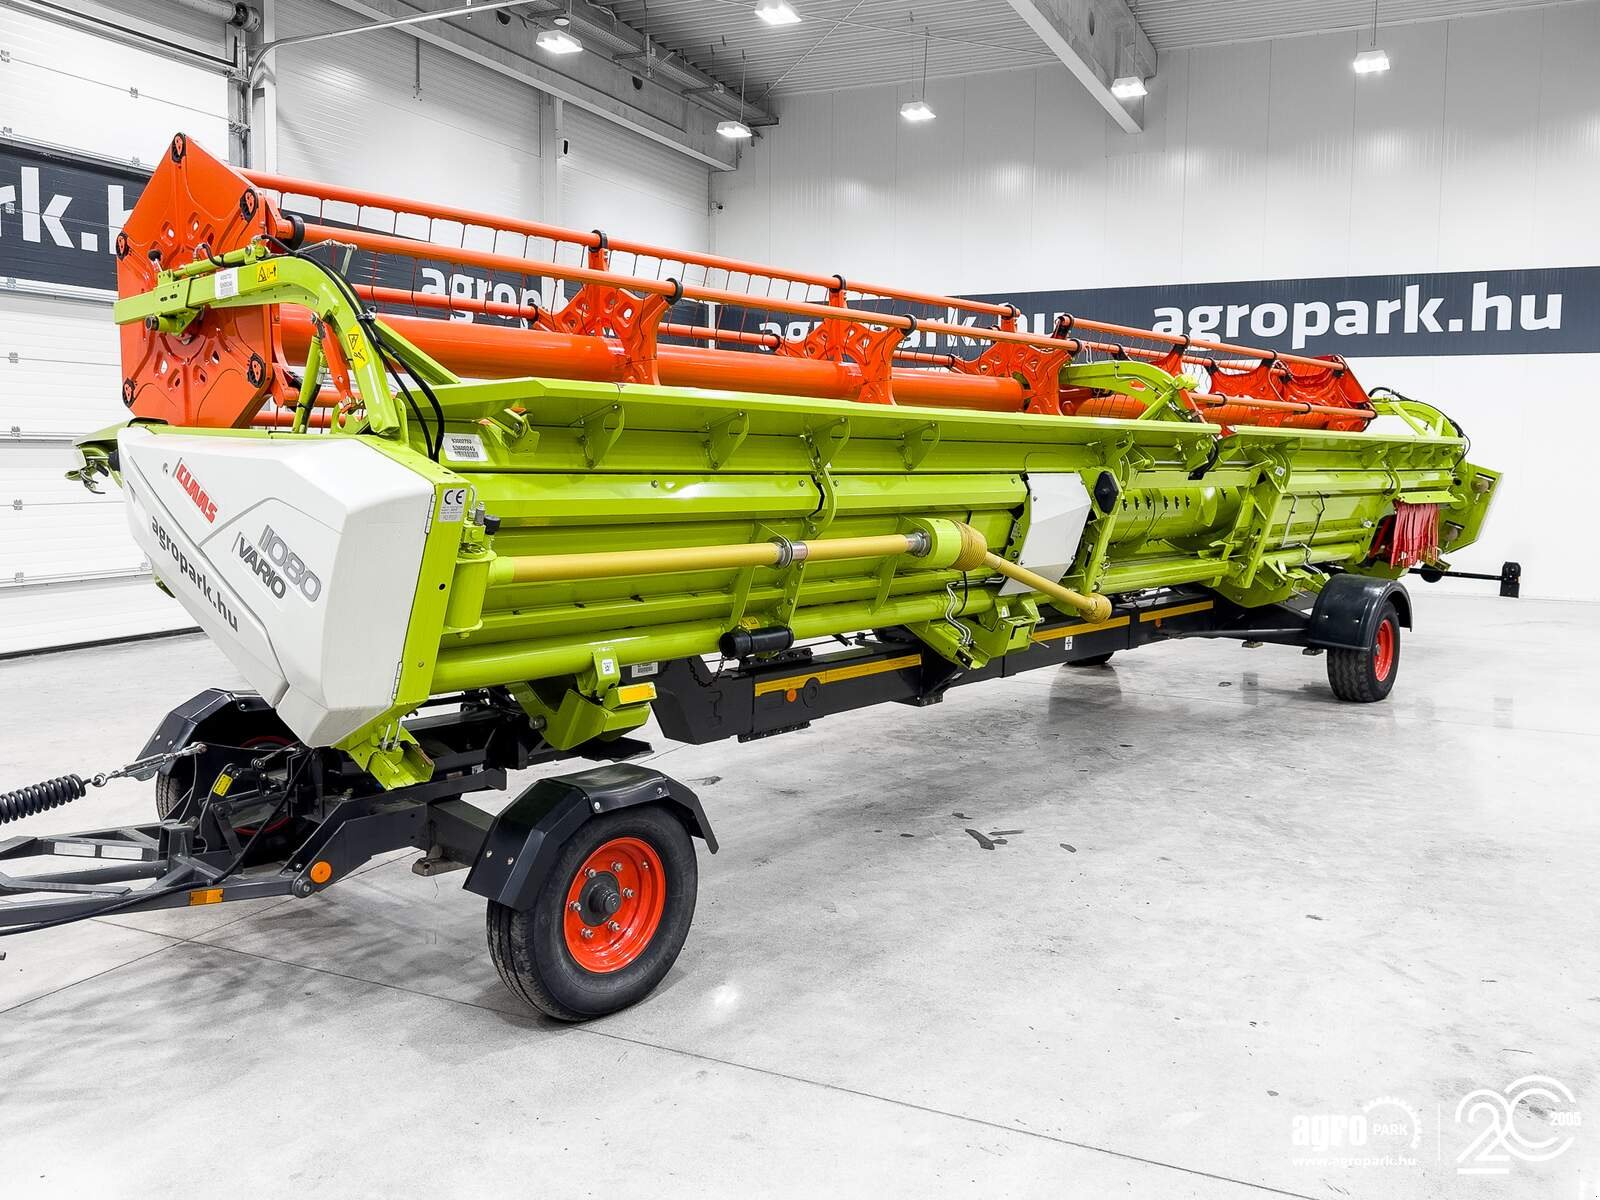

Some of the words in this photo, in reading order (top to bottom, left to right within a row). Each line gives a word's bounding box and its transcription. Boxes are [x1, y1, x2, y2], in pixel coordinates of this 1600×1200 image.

[1152, 281, 1562, 351] agropark.hu
[176, 463, 218, 523] CLAAS
[151, 515, 239, 633] agropark.hu
[238, 535, 286, 600] VARIO
